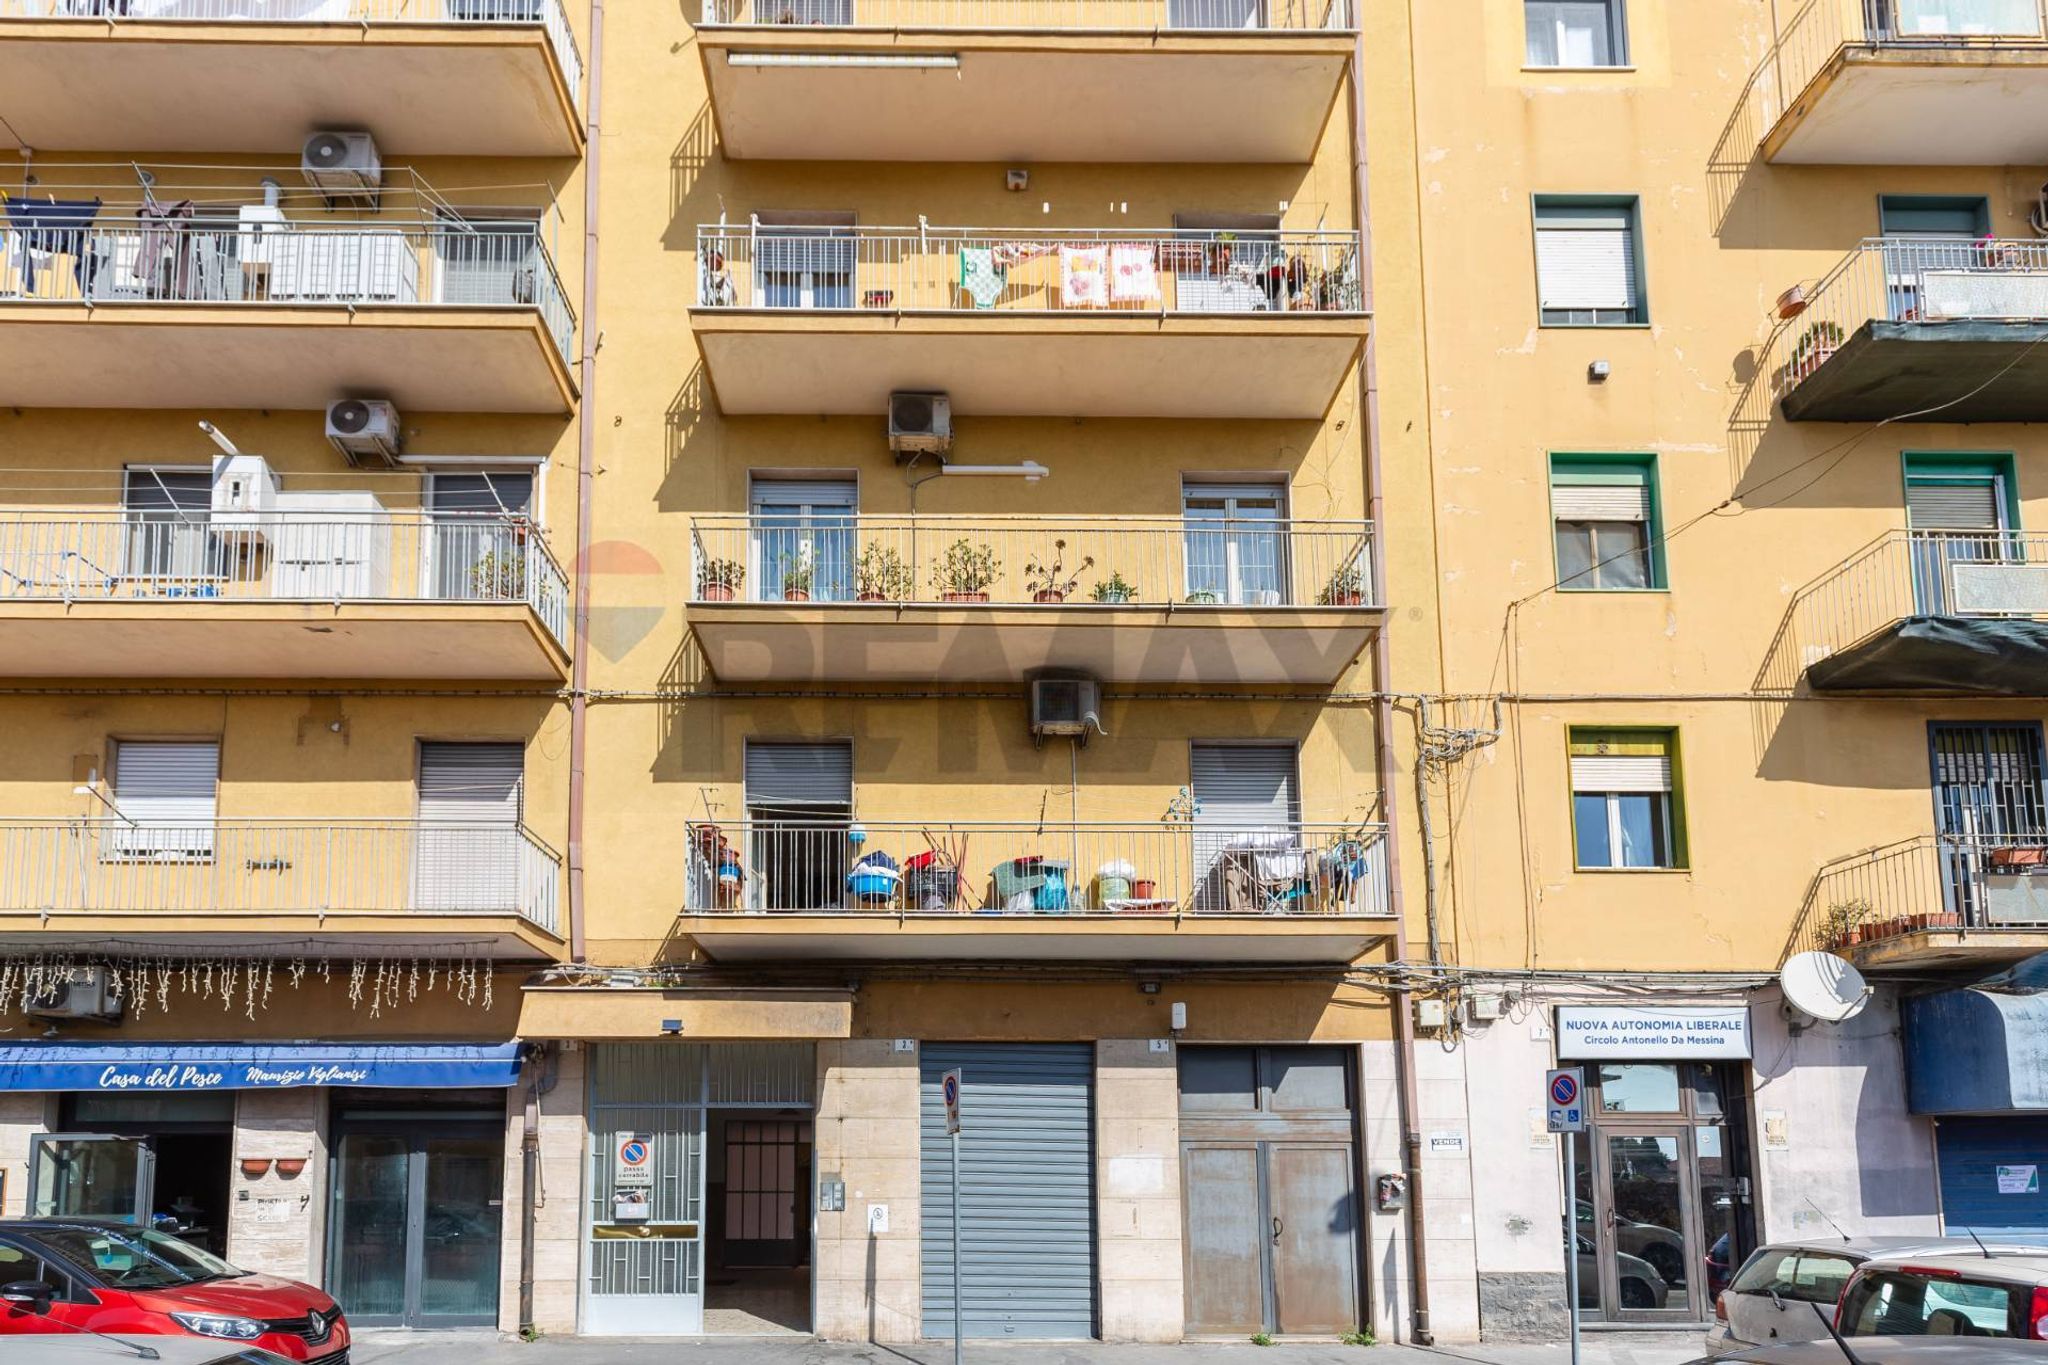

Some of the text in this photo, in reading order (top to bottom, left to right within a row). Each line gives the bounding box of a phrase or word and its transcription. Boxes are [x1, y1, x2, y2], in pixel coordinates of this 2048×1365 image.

[1566, 1020, 1742, 1030] NUOVA AUTONOMIA LIBERALE
[1584, 1035, 1725, 1044] Circolo Antonello Da Messina
[99, 1065, 142, 1088] Casa
[144, 1064, 178, 1088] del
[180, 1066, 223, 1087] Pesce
[246, 1066, 306, 1085] Maurizio
